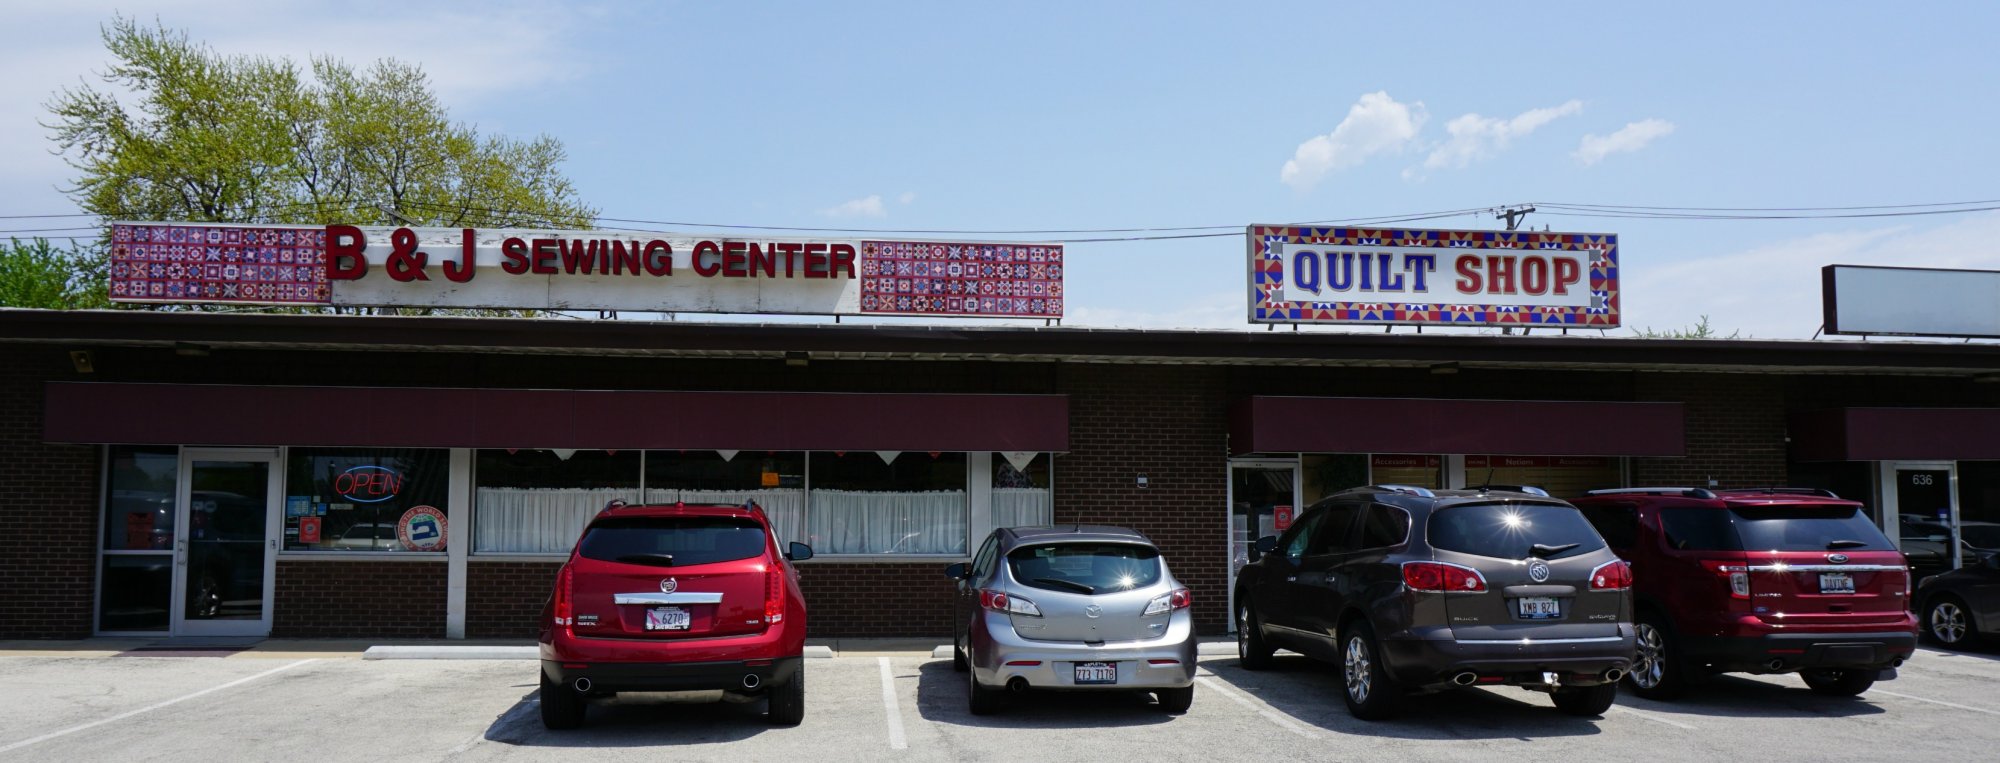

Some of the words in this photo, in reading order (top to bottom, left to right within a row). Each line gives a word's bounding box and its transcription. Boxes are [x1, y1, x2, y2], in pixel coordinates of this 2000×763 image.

[326, 225, 368, 281] B
[386, 227, 431, 283] &
[442, 228, 476, 283] J
[501, 237, 673, 277] SEWING
[691, 240, 857, 279] CENTER
[1292, 250, 1437, 296] QUILT
[1455, 254, 1581, 296] SHOP
[335, 473, 402, 495] OPEN
[1912, 474, 1933, 485] 636
[417, 507, 440, 518] WORLD
[662, 613, 684, 624] 6270
